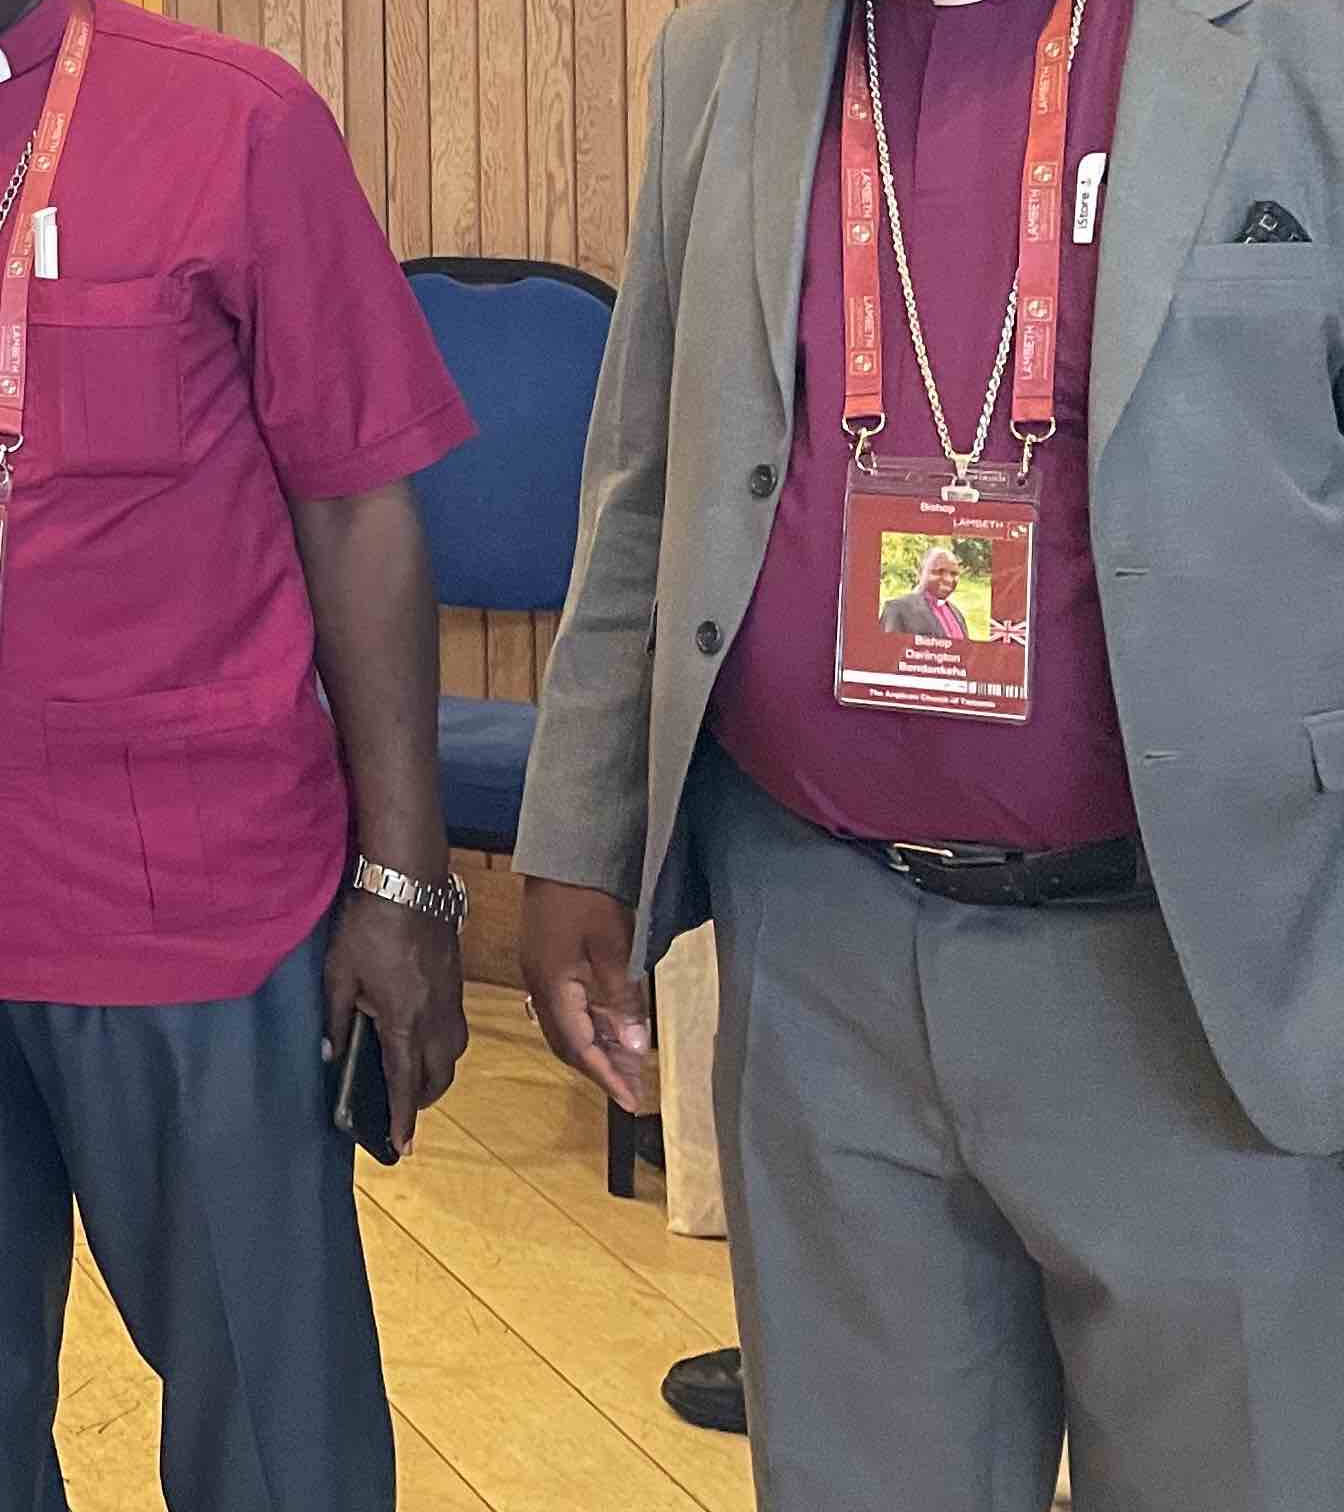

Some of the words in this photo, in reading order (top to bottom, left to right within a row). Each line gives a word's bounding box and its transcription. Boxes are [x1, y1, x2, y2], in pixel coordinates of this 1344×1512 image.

[1076, 192, 1090, 230] iStore
[920, 502, 956, 514] Bishop
[953, 519, 1004, 529] LAMBETH
[914, 635, 952, 649] Bishop
